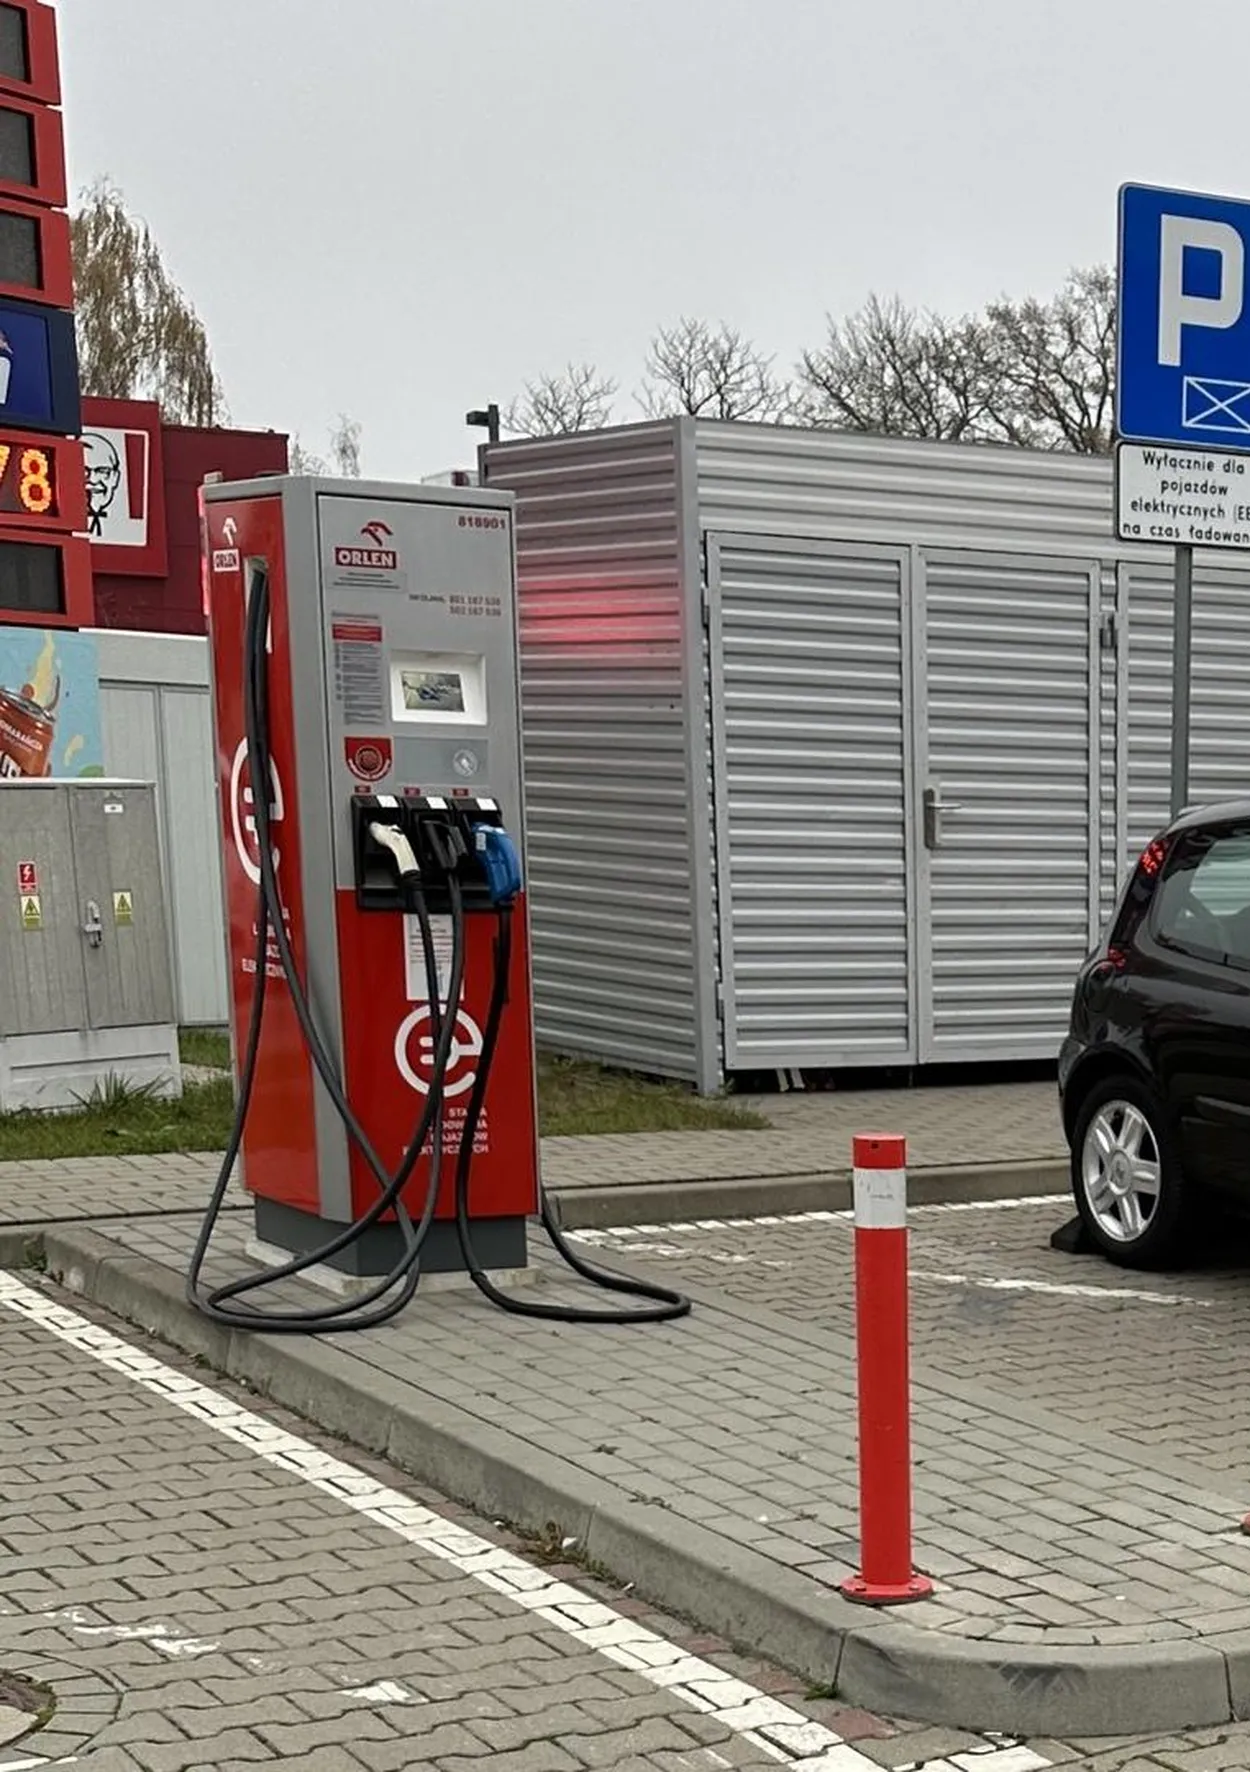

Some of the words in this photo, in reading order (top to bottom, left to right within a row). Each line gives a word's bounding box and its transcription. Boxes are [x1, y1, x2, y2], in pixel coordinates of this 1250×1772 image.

[1157, 213, 1244, 367] P
[1142, 450, 1215, 473] Wyłącznie
[1222, 459, 1245, 474] dla
[1161, 477, 1229, 496] pojazdów
[1130, 497, 1226, 521] elektrycznych
[1123, 523, 1141, 535] na
[1150, 524, 1180, 539] czas
[337, 550, 394, 567] ORLEN
